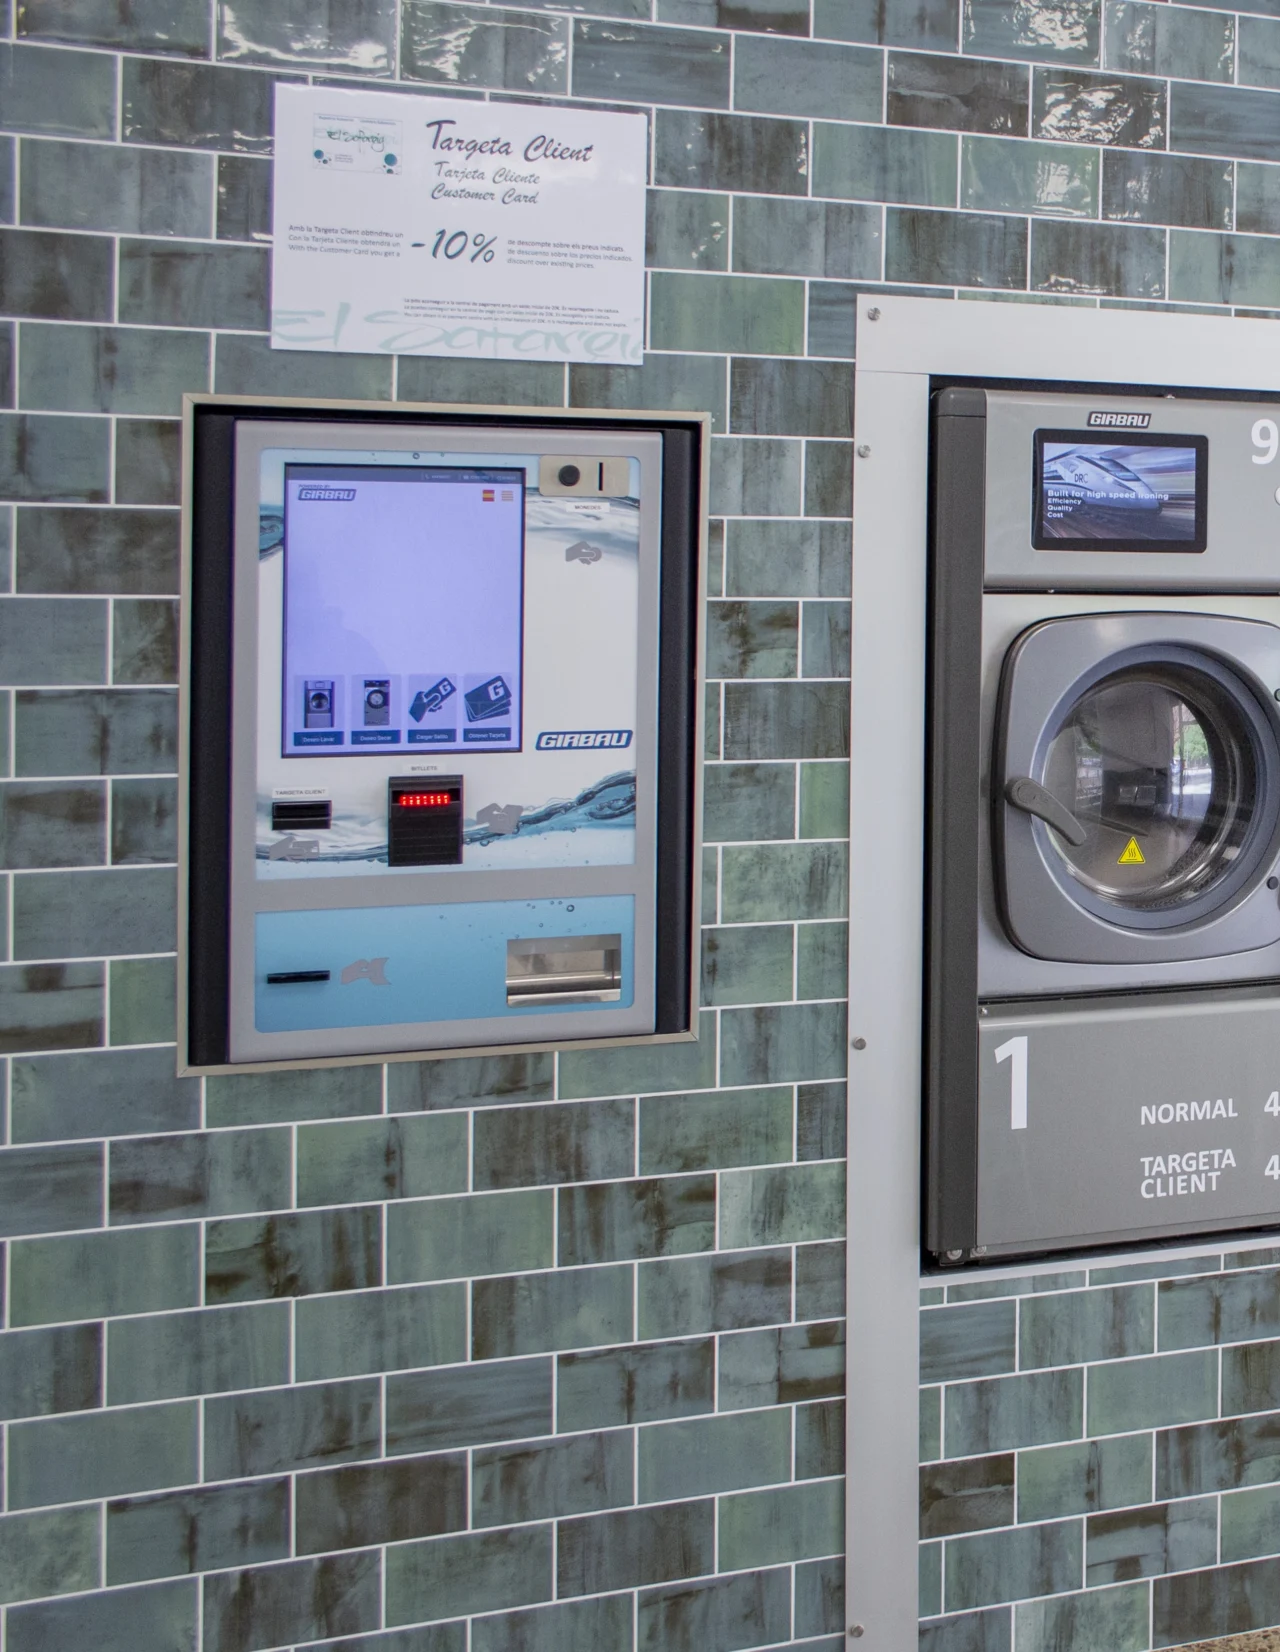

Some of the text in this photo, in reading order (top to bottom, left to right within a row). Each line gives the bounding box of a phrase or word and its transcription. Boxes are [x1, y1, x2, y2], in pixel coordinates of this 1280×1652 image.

[426, 119, 594, 162] Targeta Client
[435, 161, 540, 184] Tarjeta Cliente
[431, 183, 539, 204] Customer Card
[289, 224, 305, 232] Amb
[411, 228, 498, 263] -10%
[1090, 413, 1150, 427] GIRBAU
[1251, 418, 1279, 465] 9
[1074, 473, 1088, 484] DRC
[301, 490, 354, 500] GIRBAU
[1048, 489, 1168, 501] Built for high speed ironing
[540, 732, 629, 748] GIRBAU
[994, 1036, 1028, 1130] 1
[1140, 1098, 1238, 1125] NORMAL
[1140, 1148, 1237, 1177] TARGETA
[1140, 1171, 1221, 1199] CLIENT
